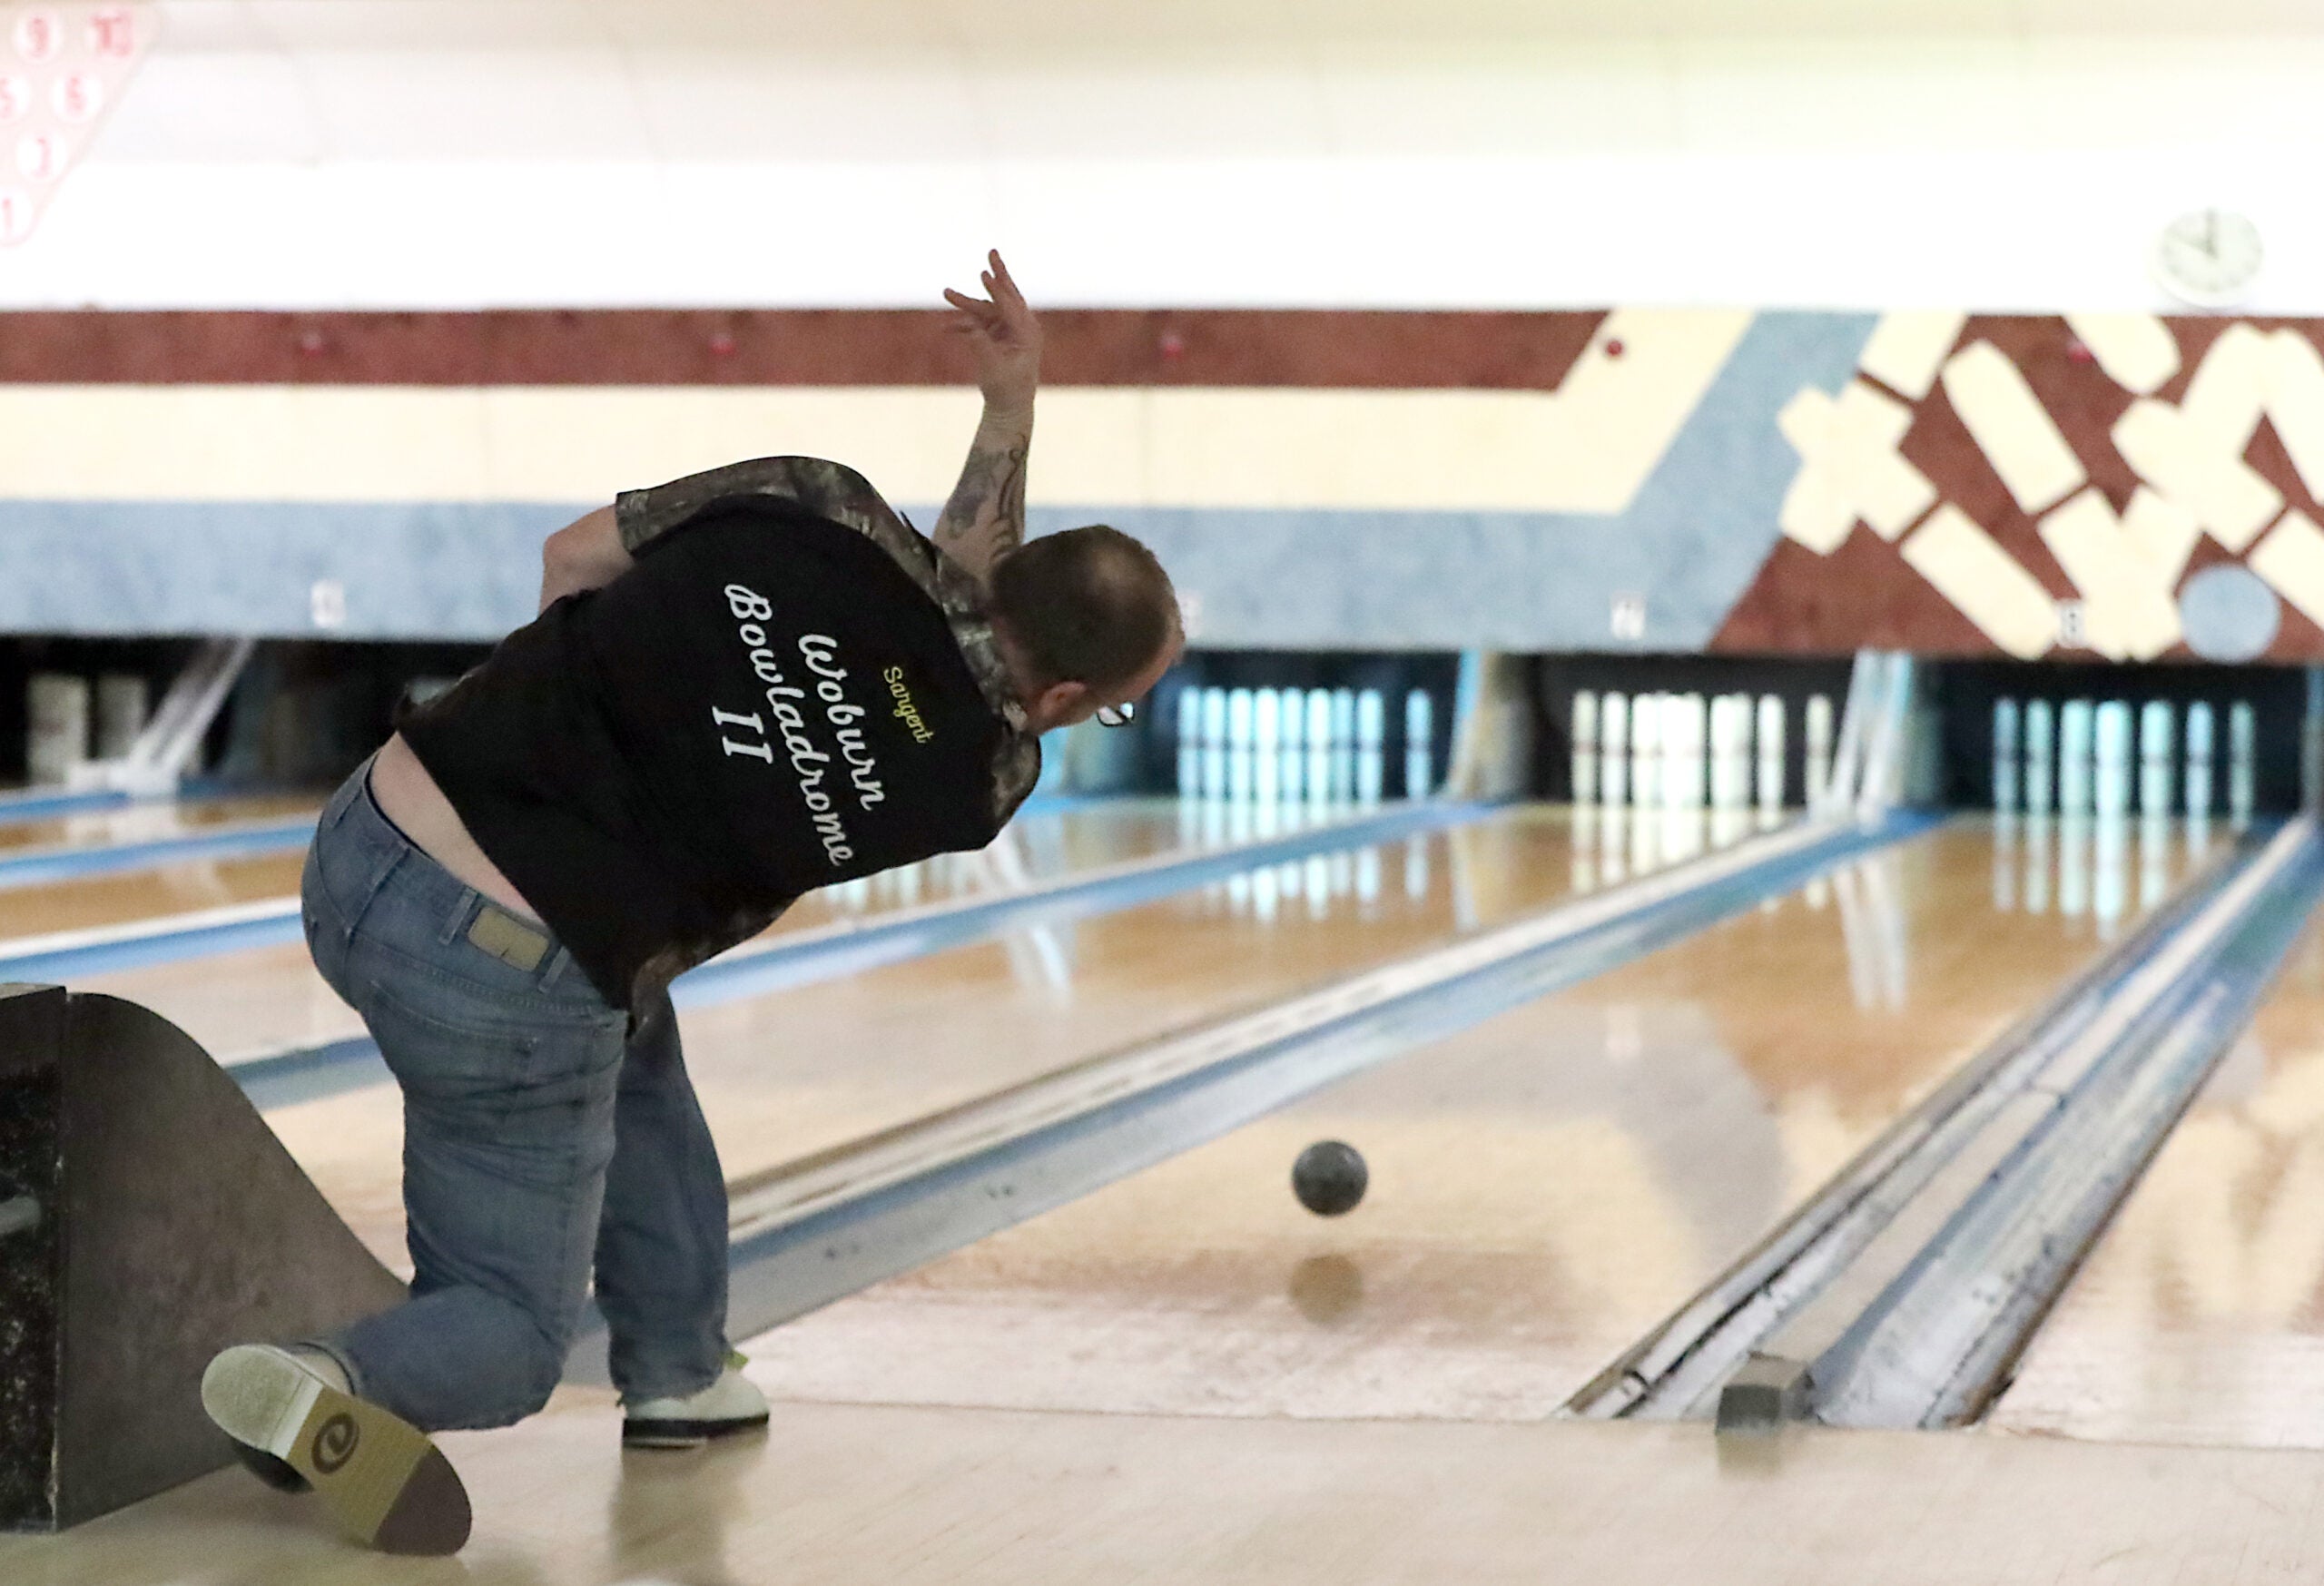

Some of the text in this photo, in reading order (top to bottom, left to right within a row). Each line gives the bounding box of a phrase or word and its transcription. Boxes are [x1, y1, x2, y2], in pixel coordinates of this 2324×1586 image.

[724, 584, 853, 867] Bowladrome
[798, 634, 885, 811] Woburn
[883, 665, 934, 744] Sargent
